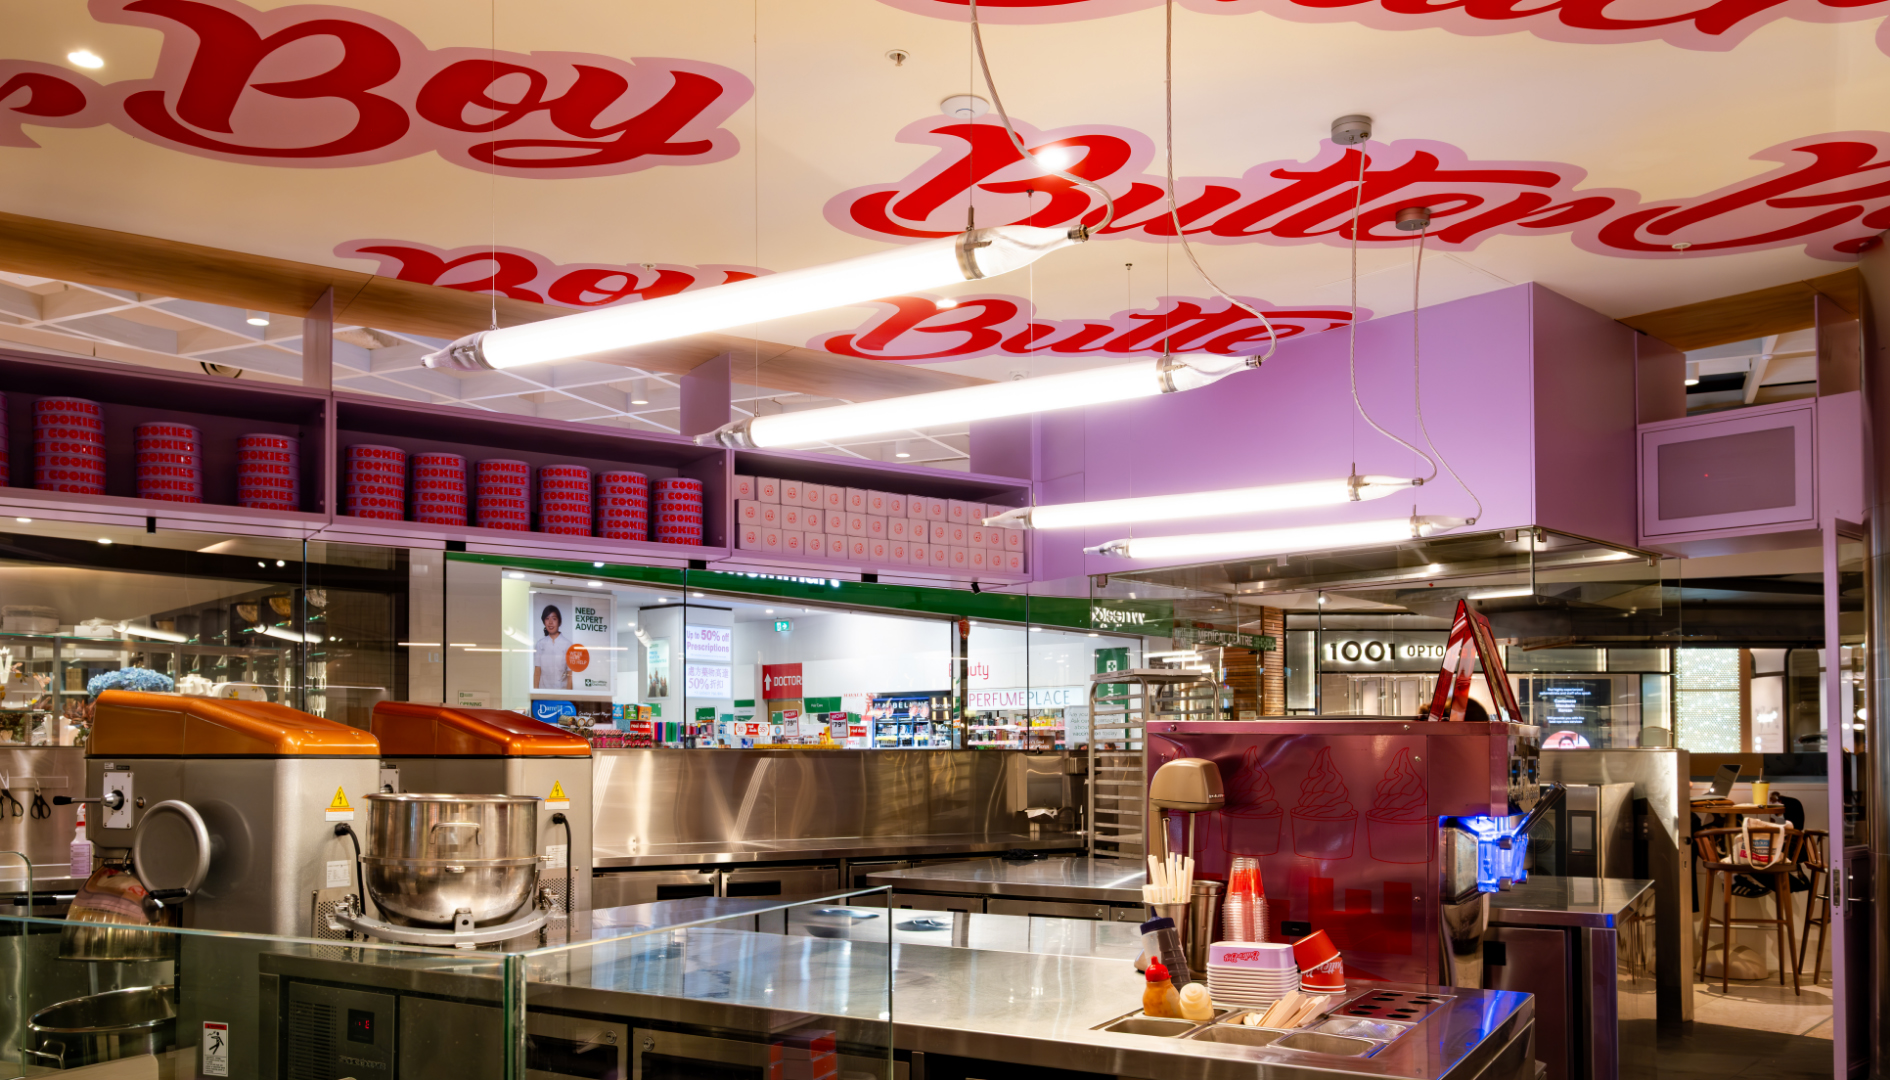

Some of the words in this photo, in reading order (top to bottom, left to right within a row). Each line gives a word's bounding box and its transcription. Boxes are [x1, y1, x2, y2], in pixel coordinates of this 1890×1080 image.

[122, 0, 724, 168] Boy
[850, 123, 1615, 244] Butter
[824, 297, 1353, 361] Butte
[38, 400, 99, 416] COOKIES
[41, 414, 101, 430] COOKIES
[48, 428, 105, 445] COOKIE
[50, 442, 106, 459] COOKIE
[50, 456, 106, 473] COOKIE
[479, 463, 526, 474] COOKIES
[49, 470, 105, 486] COOKIE
[416, 468, 464, 480] COOKIES
[542, 468, 587, 479] COOKIES
[478, 474, 526, 485] COOKIES
[415, 480, 464, 492] COOKIES
[543, 480, 588, 491] COOKIES
[544, 492, 589, 502] COOKIES
[610, 486, 648, 498] COOKIE
[361, 497, 405, 512] COOKIE
[478, 498, 525, 509] COOKIES
[611, 498, 648, 509] COOKIE
[479, 510, 525, 520] COOKIES
[657, 526, 700, 536] COOKIES
[575, 607, 596, 615] NEED
[576, 615, 603, 624] EXPERT
[575, 623, 608, 632] ADVICE?
[701, 630, 720, 641] 50%
[687, 642, 729, 653] Prescriptions
[1330, 640, 1395, 662] 1001
[1407, 645, 1444, 658] OPTO
